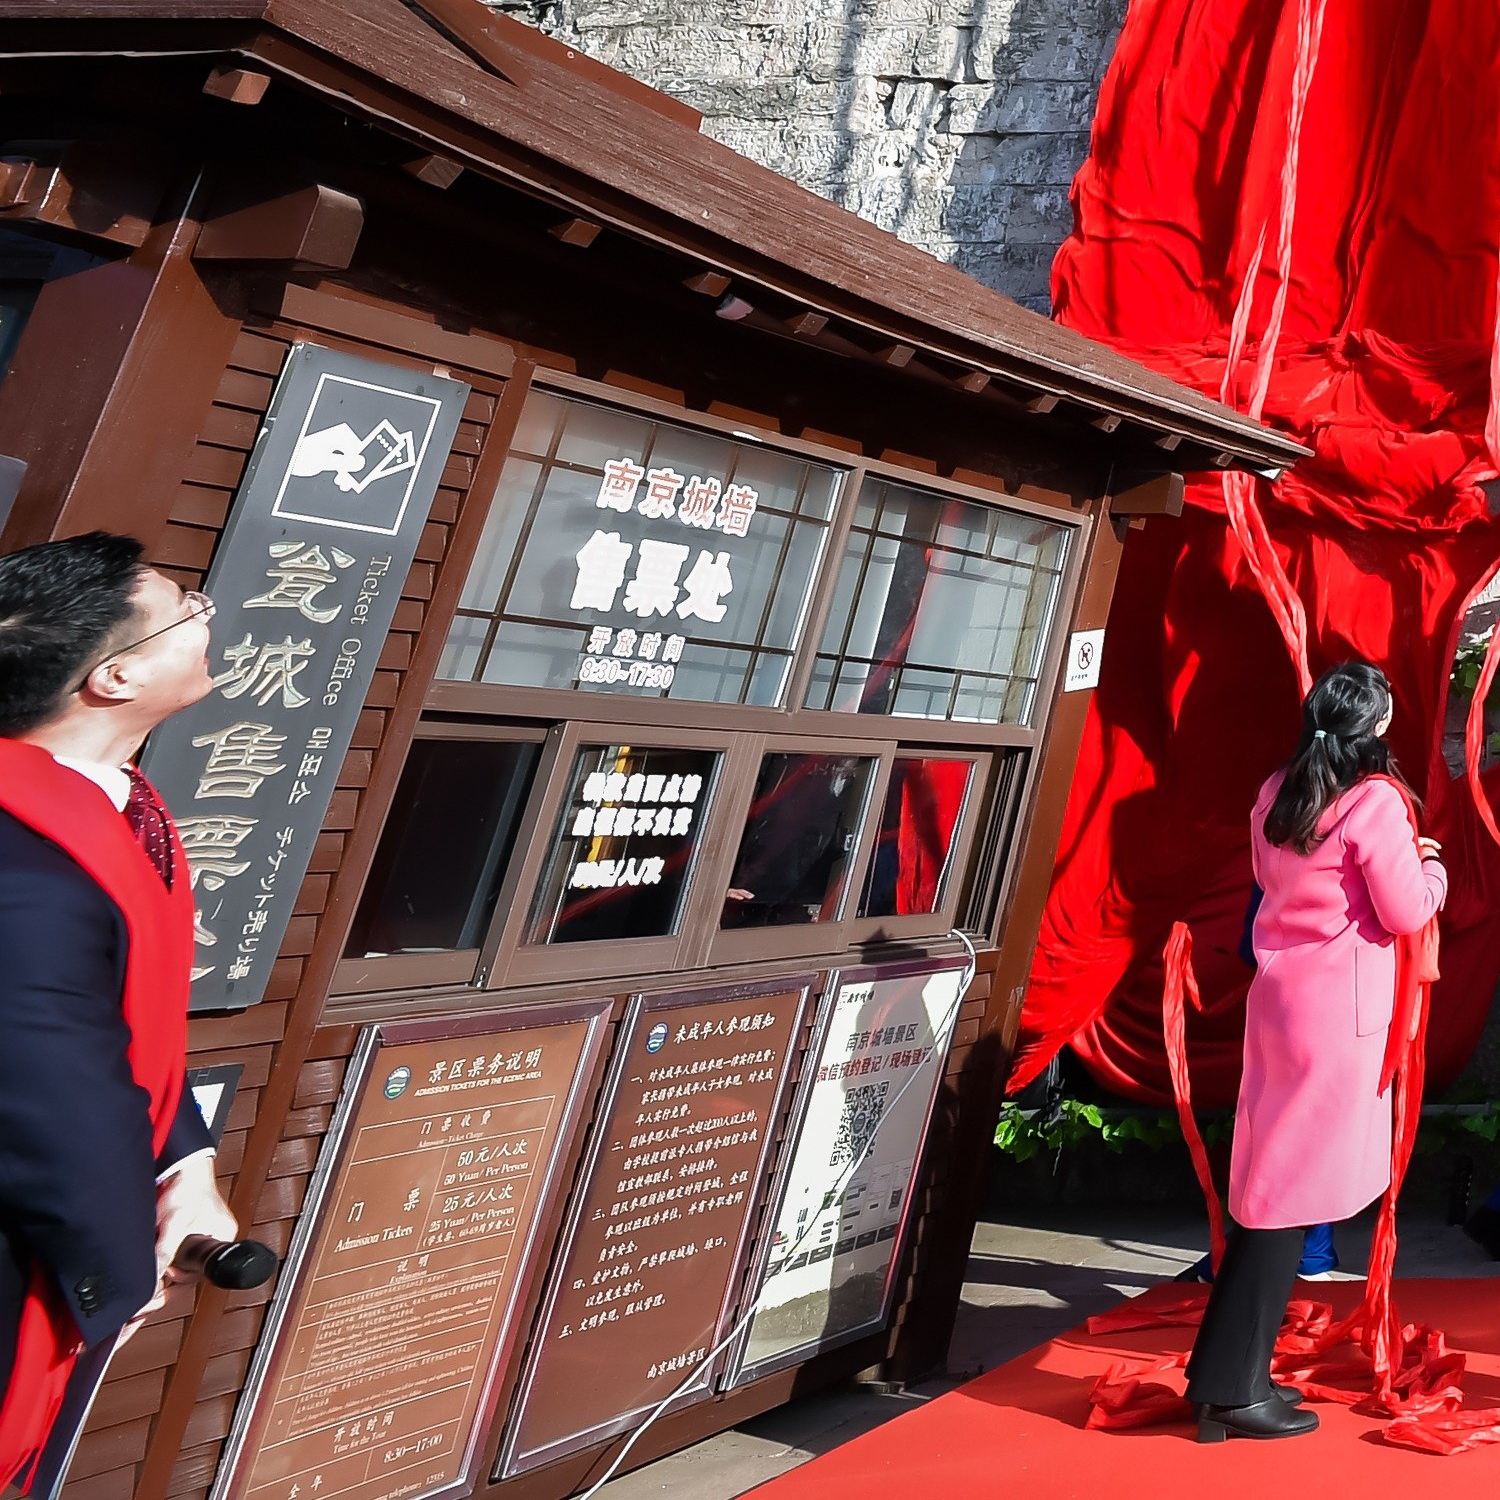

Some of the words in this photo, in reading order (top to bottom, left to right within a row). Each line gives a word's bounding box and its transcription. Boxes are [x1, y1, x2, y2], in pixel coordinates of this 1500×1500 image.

[595, 458, 759, 537] 南京城墙
[350, 555, 392, 625] Ticket
[587, 625, 686, 662] 开放时间
[322, 638, 361, 706] Office
[174, 541, 356, 981] 瓮城售票
[288, 726, 333, 805] 매표소
[845, 1023, 919, 1052] 南京城墙景区
[428, 1048, 543, 1084] 景区票务说明
[457, 1138, 528, 1168] 50元/人次
[442, 1182, 513, 1213] 25元/人次
[334, 1234, 380, 1253] Admission
[382, 1224, 413, 1241] Tickets
[333, 1410, 396, 1443] 开放时间
